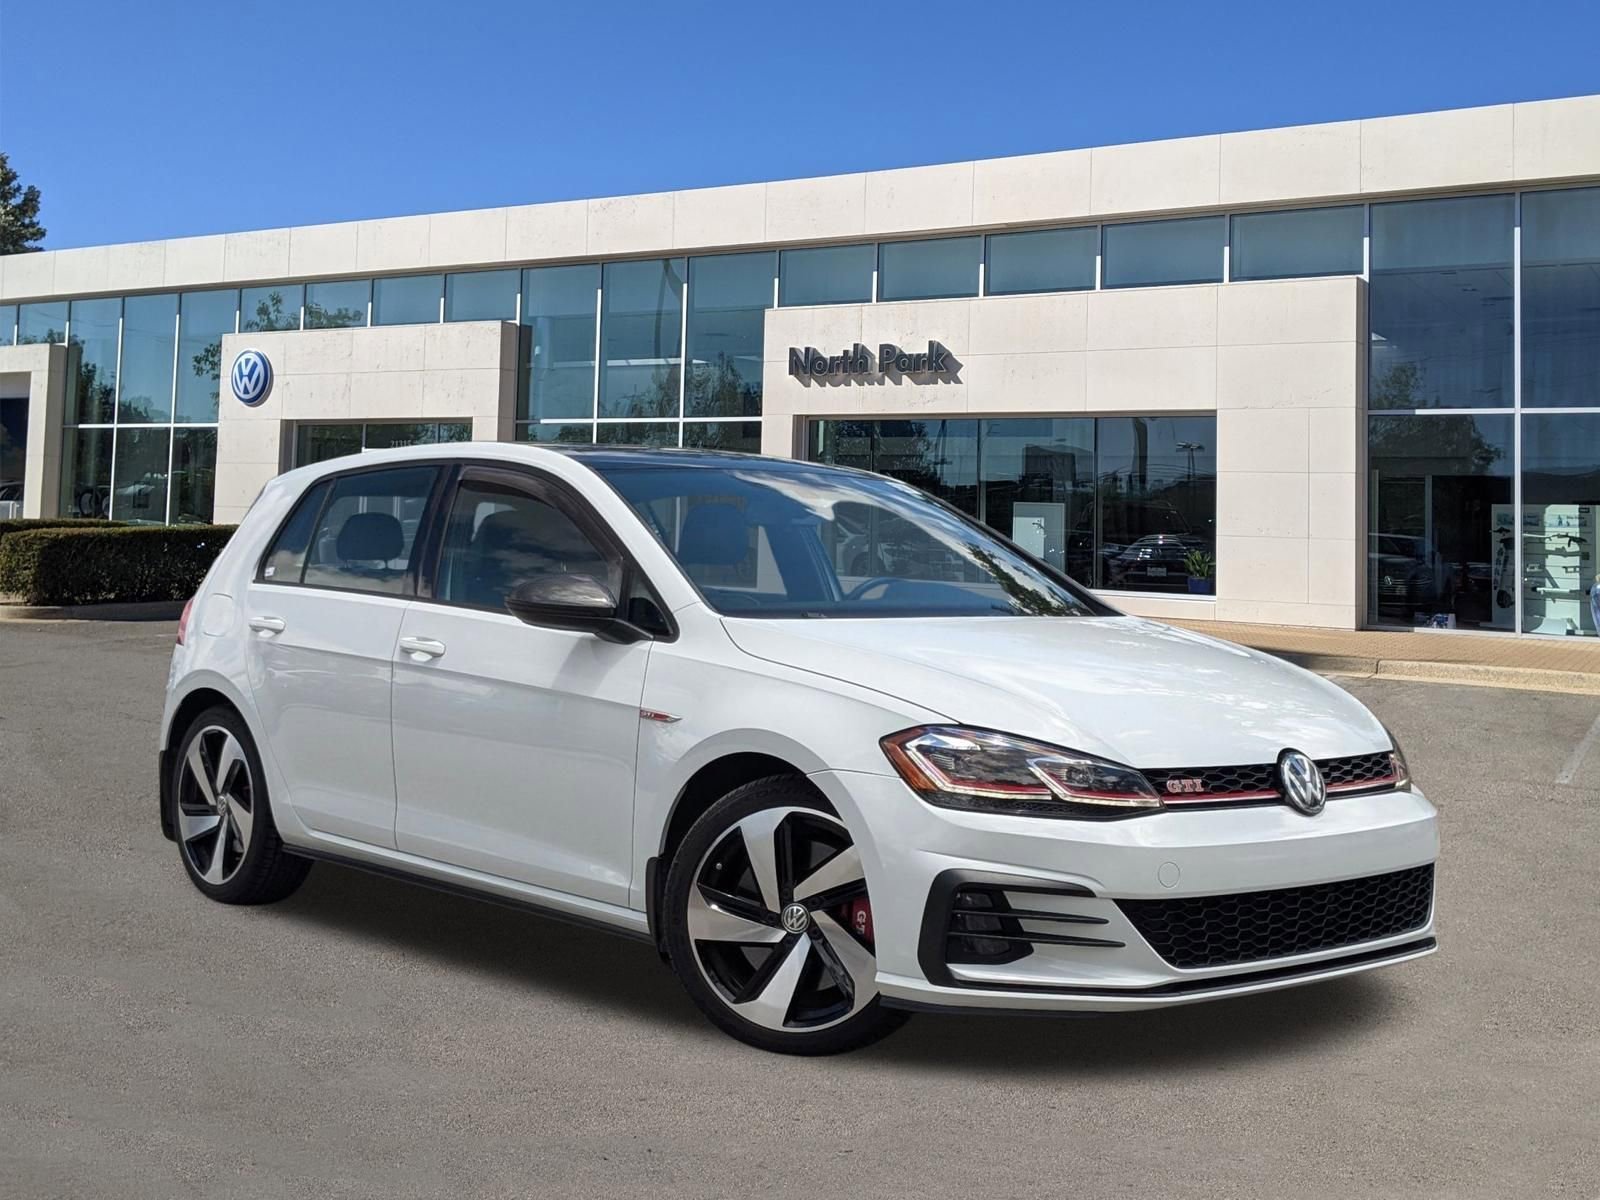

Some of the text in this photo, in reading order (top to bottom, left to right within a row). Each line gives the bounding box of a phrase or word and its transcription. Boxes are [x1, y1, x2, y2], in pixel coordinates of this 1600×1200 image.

[233, 352, 265, 400] VW
[788, 340, 947, 376] North Park
[1166, 778, 1204, 793] GTI
[1281, 754, 1325, 814] VW
[783, 905, 808, 931] VW
